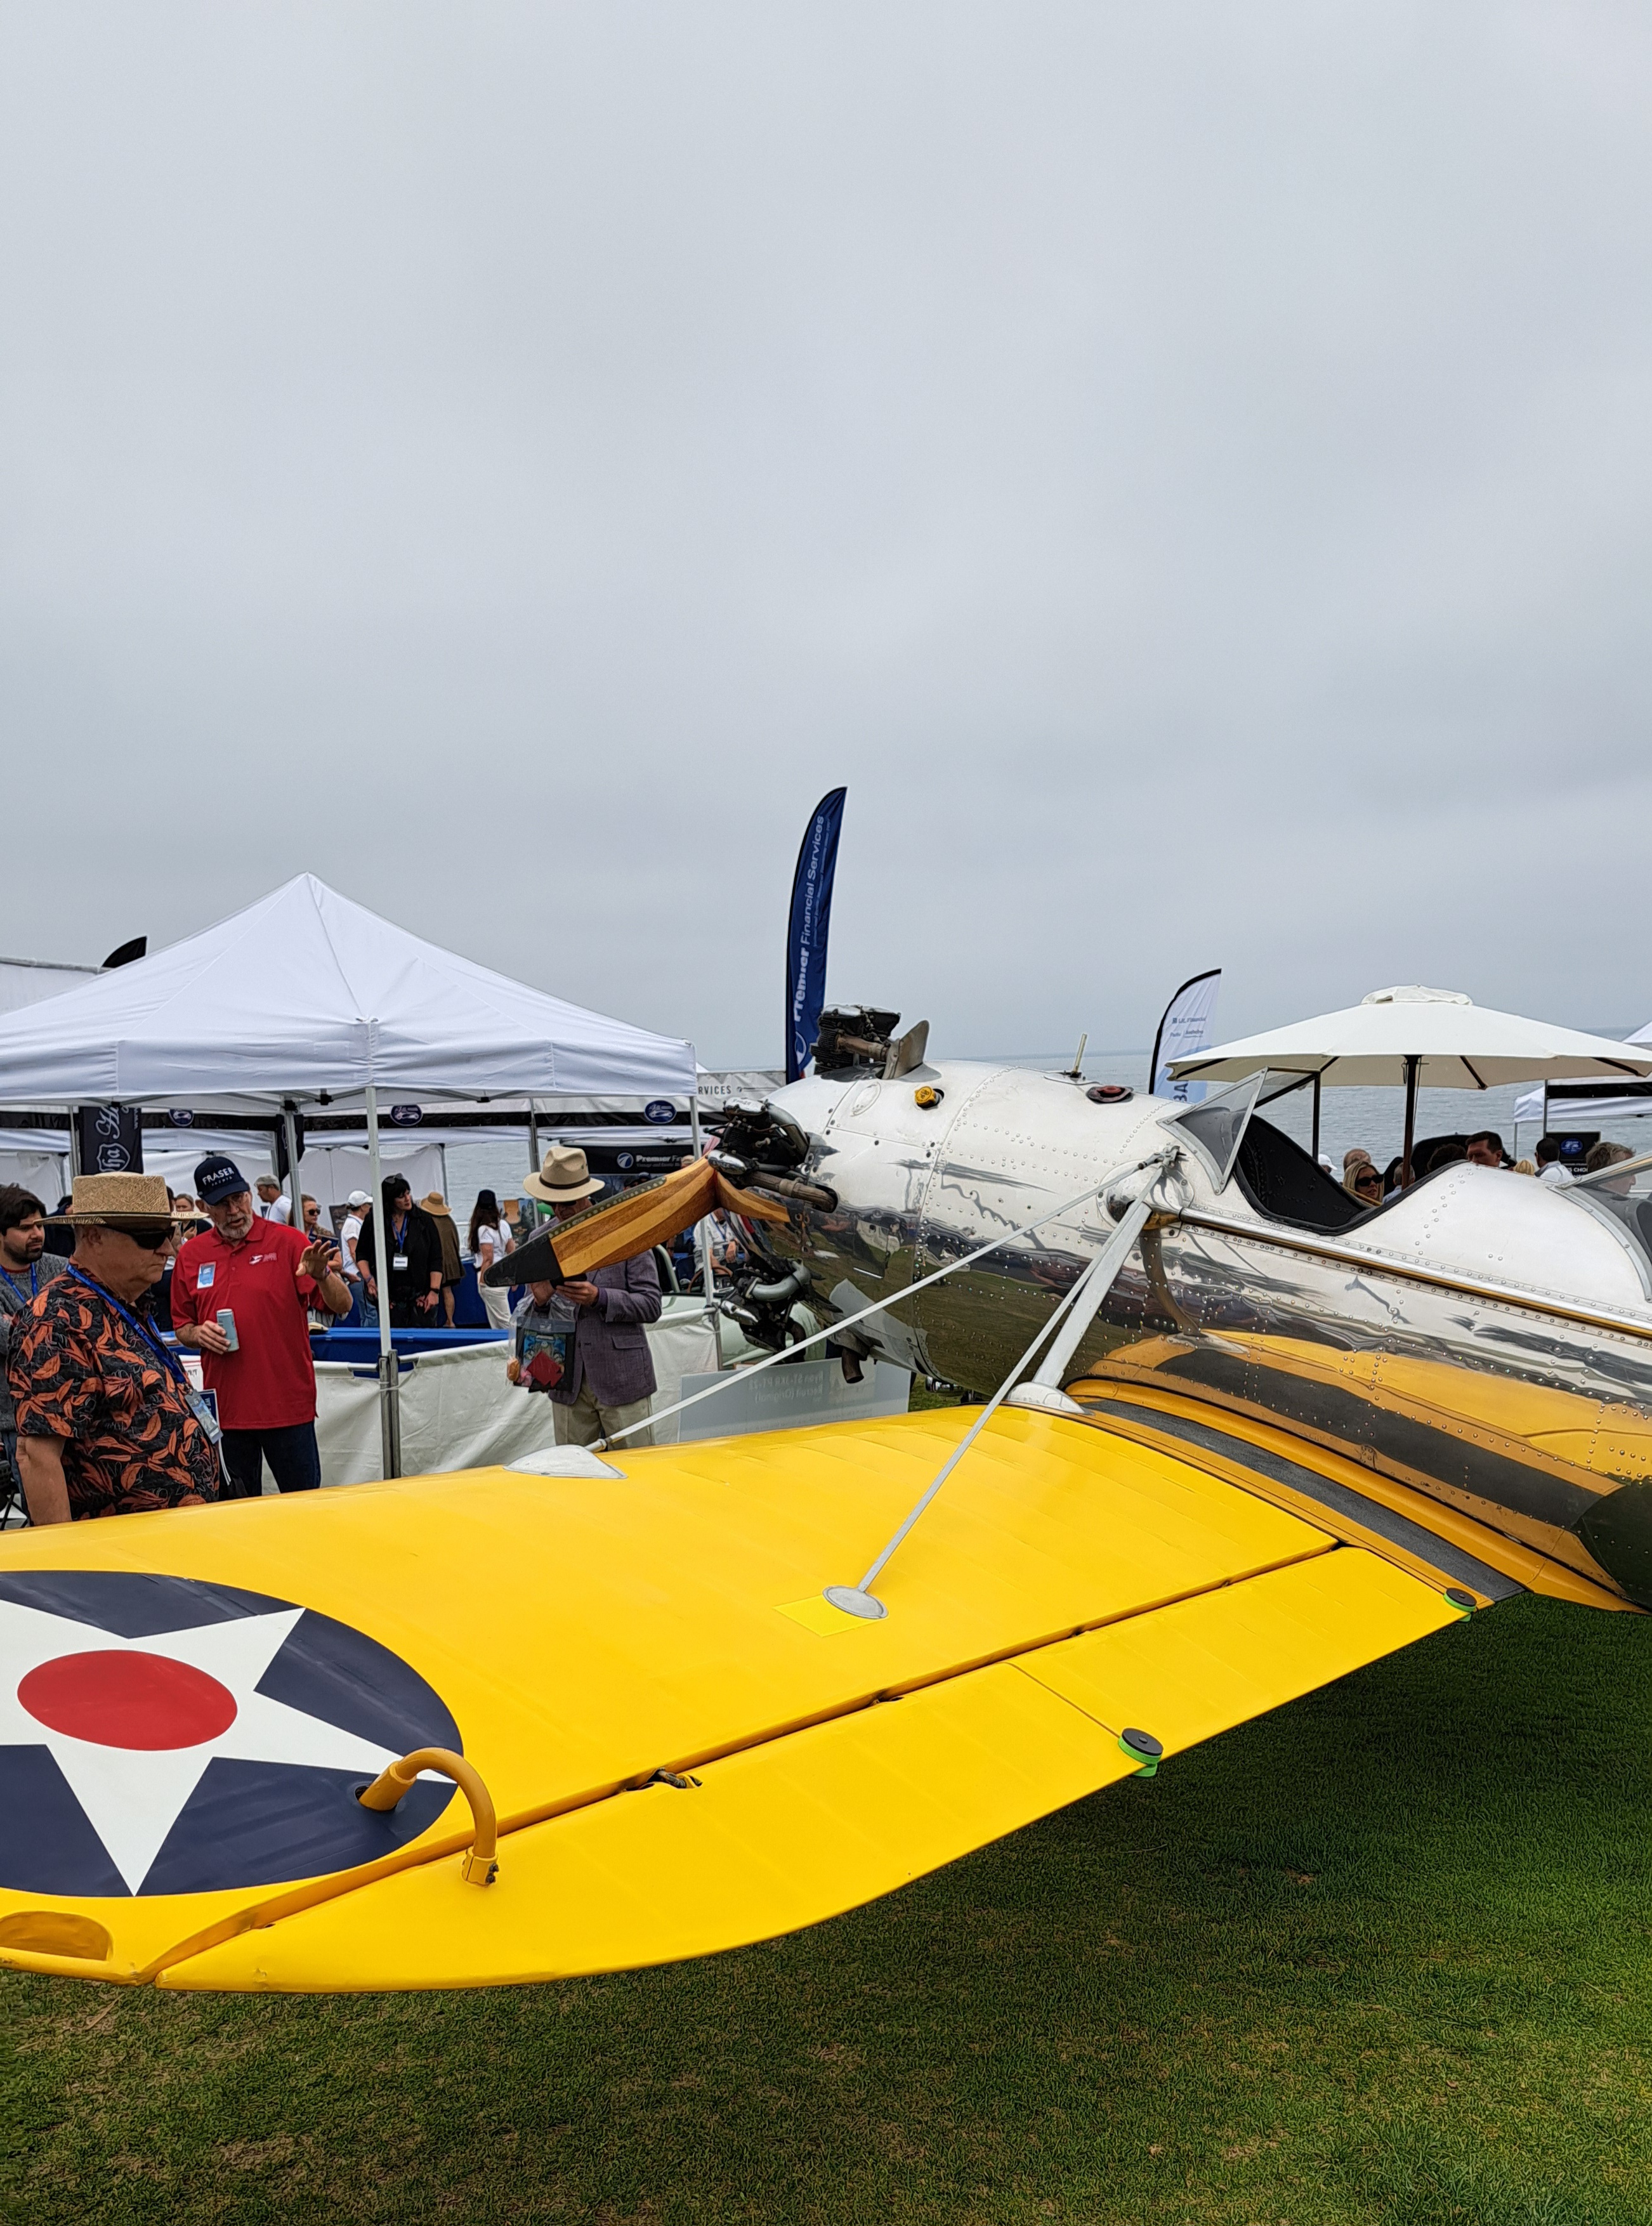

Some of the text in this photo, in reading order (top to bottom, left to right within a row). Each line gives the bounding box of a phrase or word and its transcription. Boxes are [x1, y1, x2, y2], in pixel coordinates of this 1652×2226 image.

[807, 815, 825, 881] Services
[800, 882, 815, 945] Financial
[202, 1167, 235, 1186] FRASER
[636, 1155, 671, 1163] Premier
